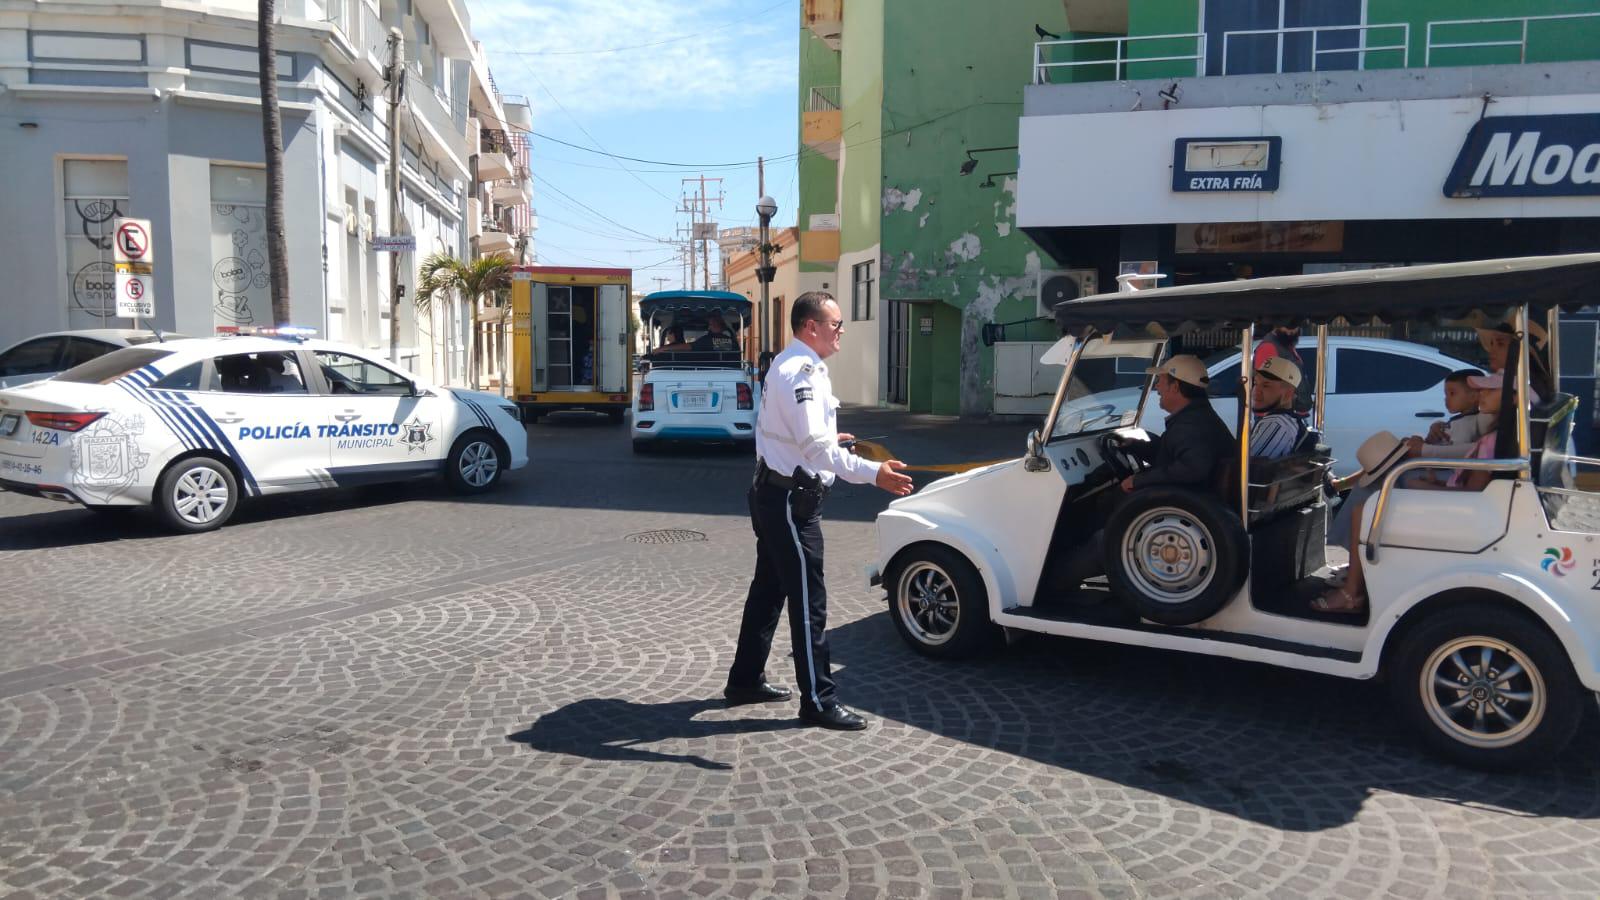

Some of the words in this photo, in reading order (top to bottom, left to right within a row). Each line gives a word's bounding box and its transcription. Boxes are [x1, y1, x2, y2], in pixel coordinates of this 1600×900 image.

[1190, 177, 1230, 189] EXTRA
[1233, 173, 1262, 189] FRÍA
[238, 422, 311, 440] POLICÍA
[316, 419, 399, 438] TRÁNSITO
[32, 431, 59, 446] 142A
[337, 438, 394, 449] MUNICIPAL
